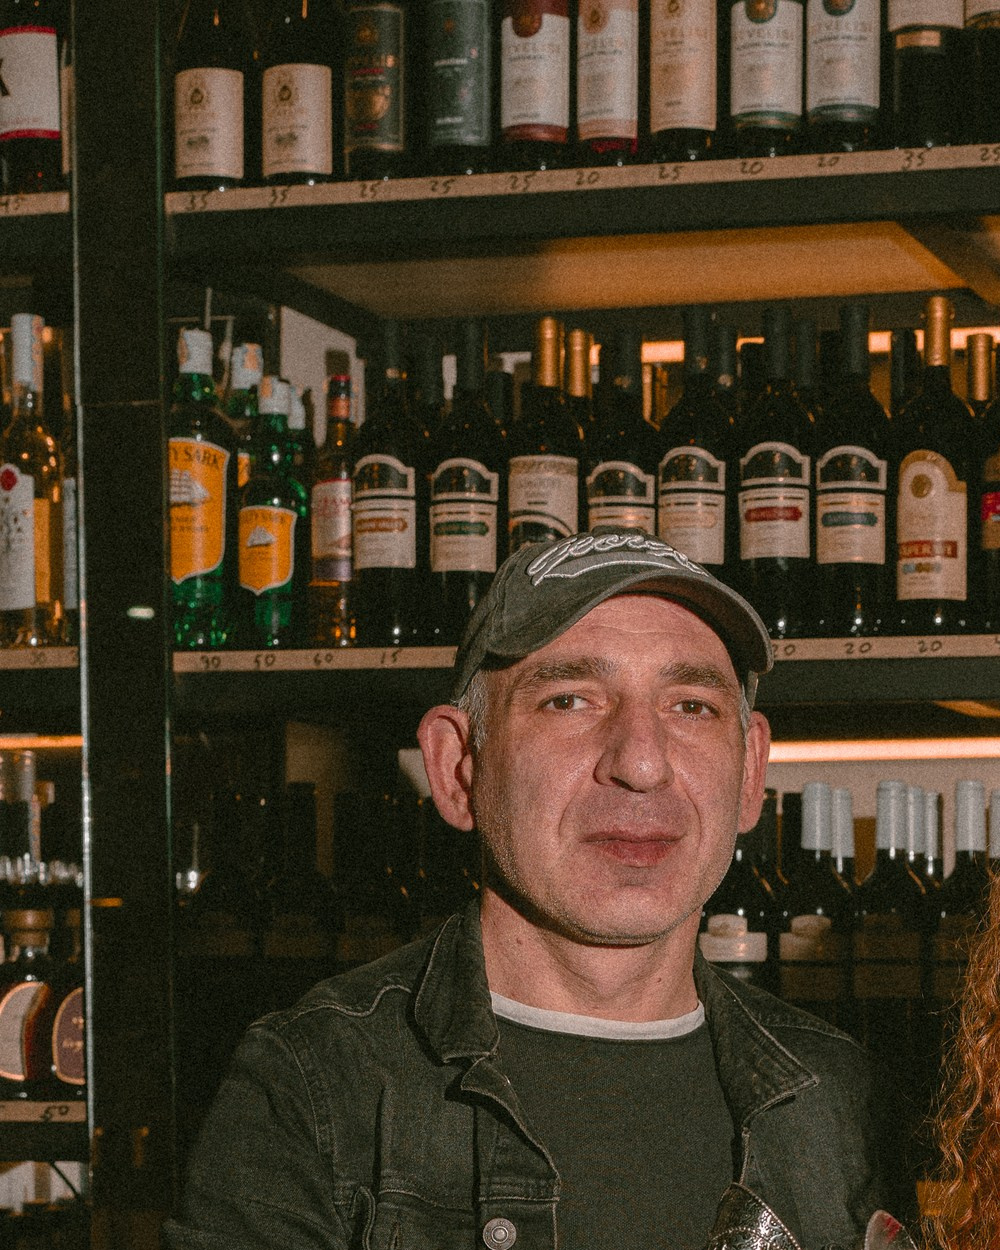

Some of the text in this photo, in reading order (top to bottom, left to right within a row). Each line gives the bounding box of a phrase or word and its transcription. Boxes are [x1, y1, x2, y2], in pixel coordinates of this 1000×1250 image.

[740, 161, 764, 176] 20
[817, 156, 840, 169] 20
[903, 149, 928, 172] 35
[576, 171, 600, 187] 20
[657, 165, 683, 182] 25
[359, 181, 381, 199] 25
[430, 177, 456, 195] 25
[510, 172, 537, 192] 25
[185, 193, 212, 212] 35
[269, 186, 294, 207] 35
[184, 446, 220, 470] SARK
[771, 644, 797, 657] 20
[845, 643, 873, 657] 20
[917, 640, 943, 654] 20
[254, 653, 276, 667] 50
[313, 653, 333, 665] 60
[379, 648, 403, 664] 15
